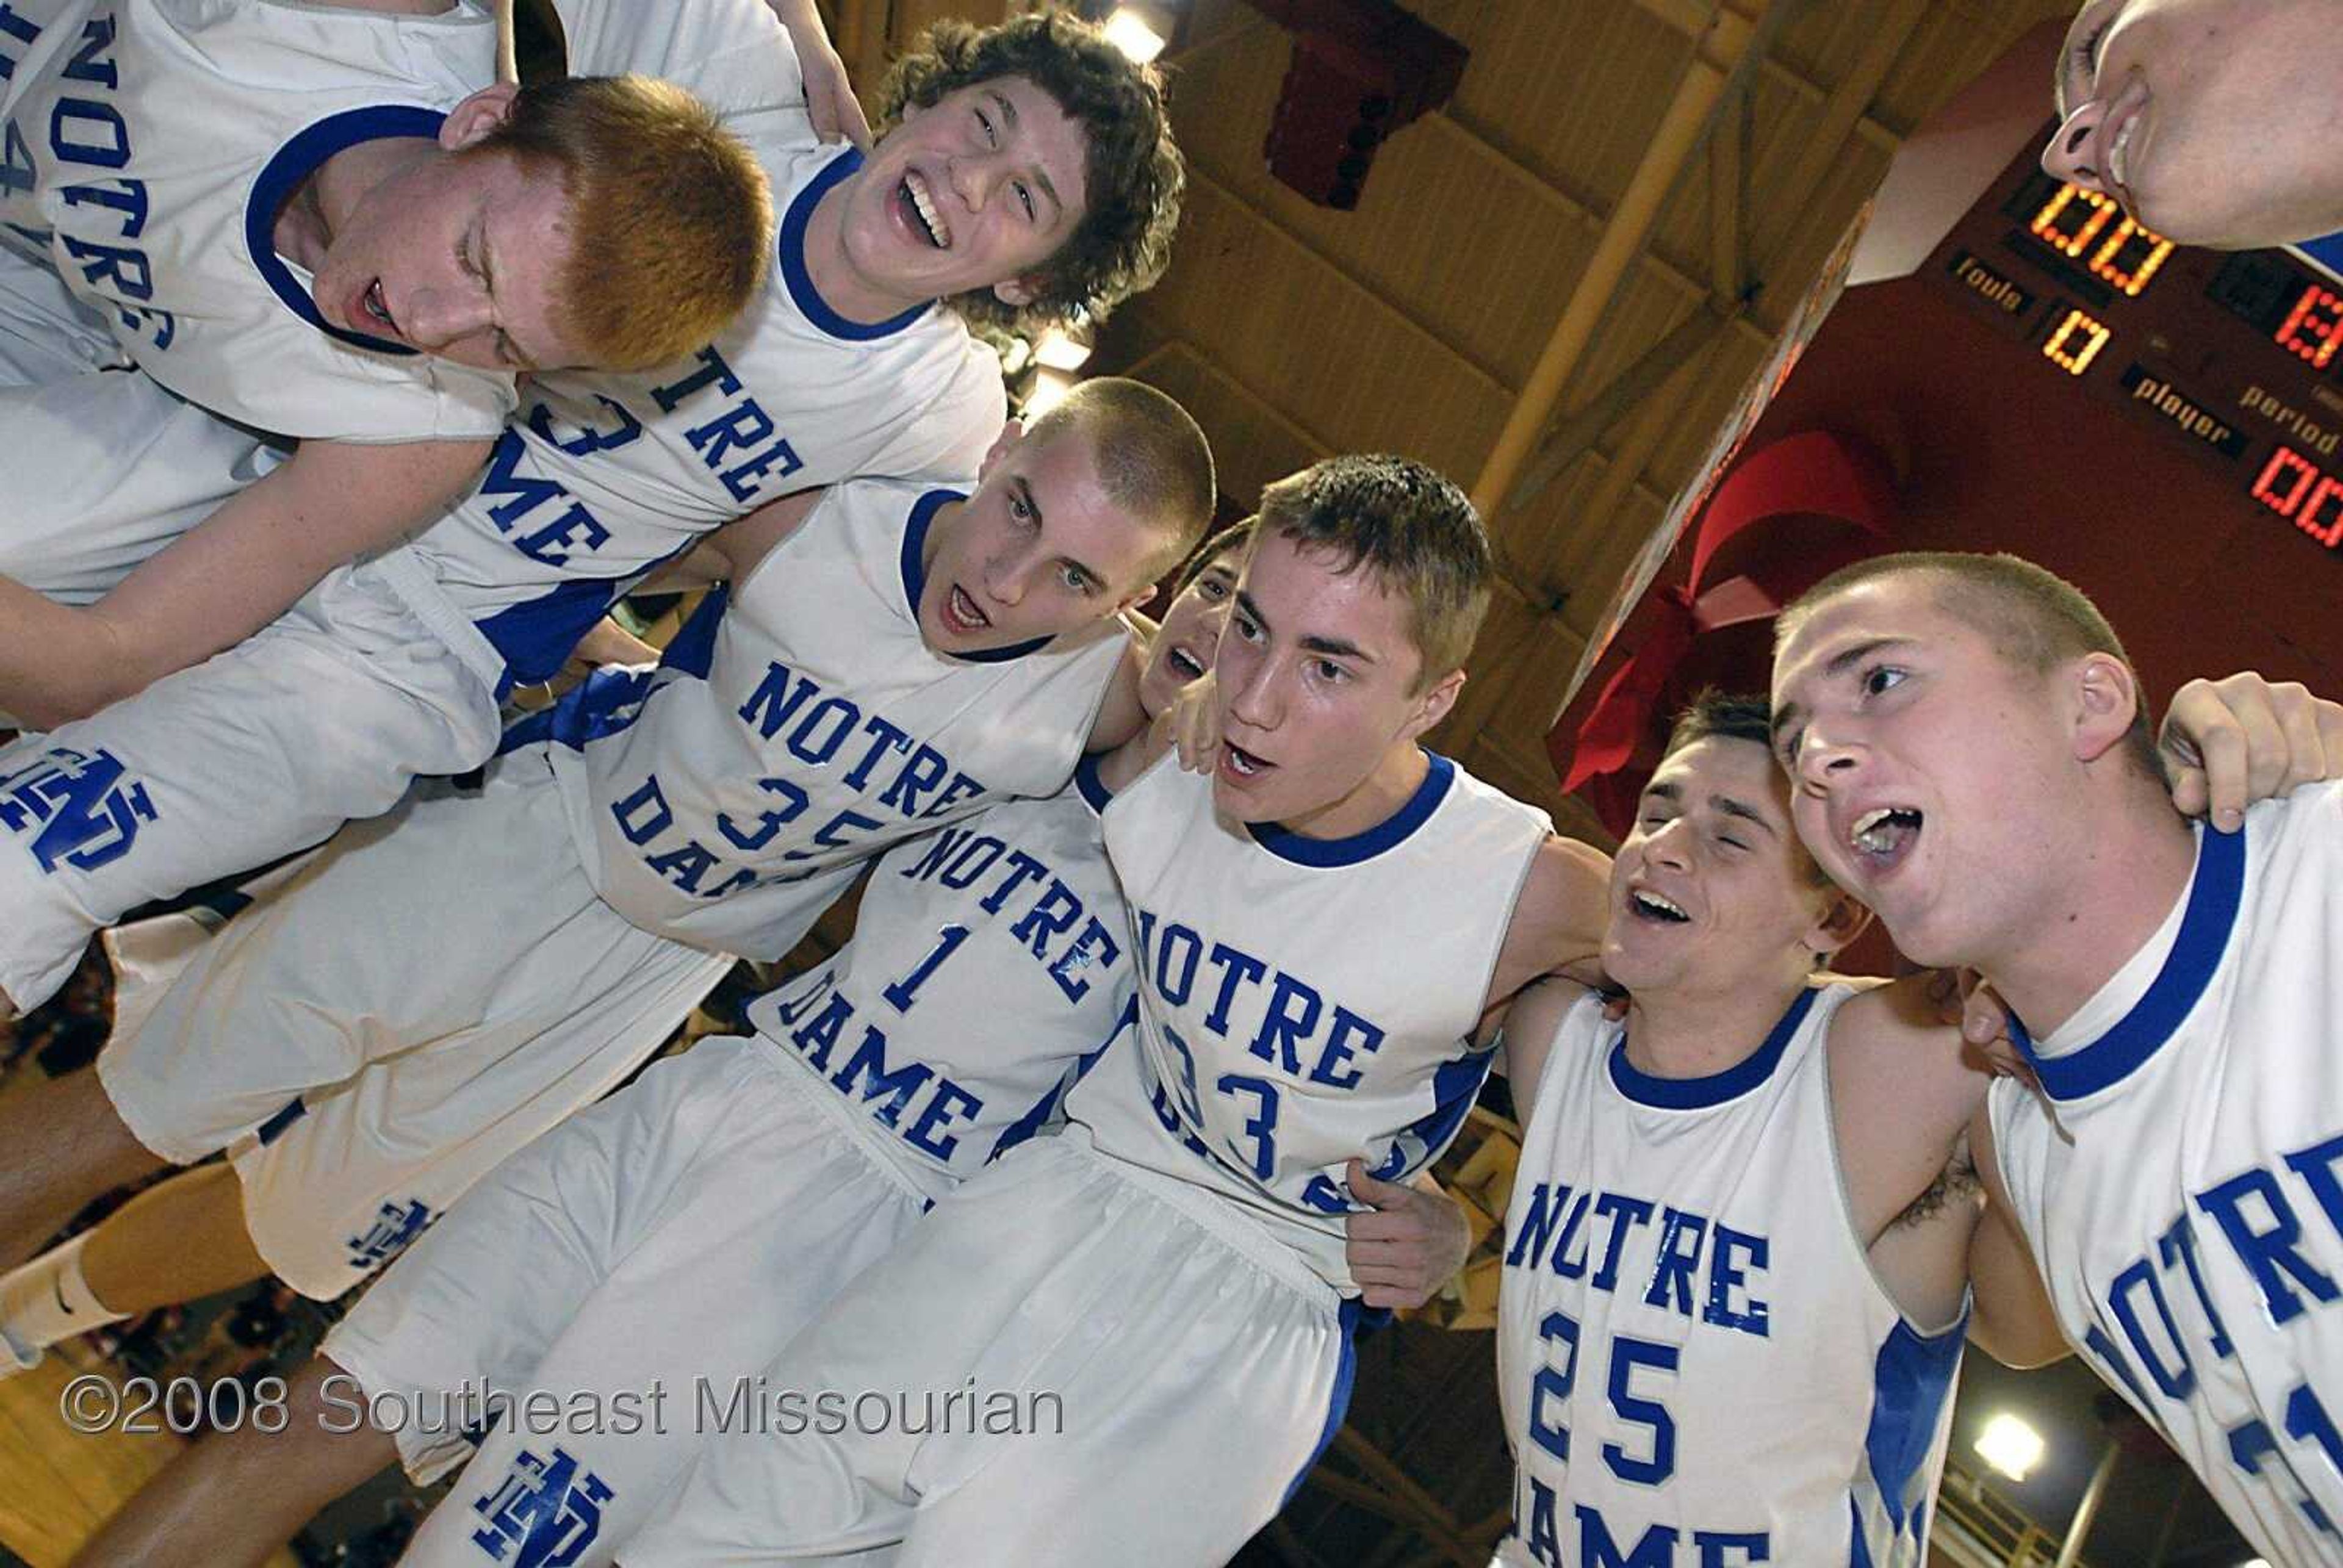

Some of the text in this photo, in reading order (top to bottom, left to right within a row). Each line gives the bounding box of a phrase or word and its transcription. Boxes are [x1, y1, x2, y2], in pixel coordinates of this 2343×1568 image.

[2030, 182, 2176, 297] 00
[650, 343, 804, 504] TRE
[2132, 377, 2232, 443] player
[2238, 386, 2340, 455] period
[478, 423, 612, 568] ME
[2251, 446, 2343, 548] 00
[738, 661, 987, 819] NOTRE
[611, 773, 819, 898] DA
[882, 922, 973, 1014] 1
[901, 828, 1121, 1005] NOTRE
[1505, 1184, 1771, 1337] NOTRE
[1529, 1311, 1680, 1487] 25
